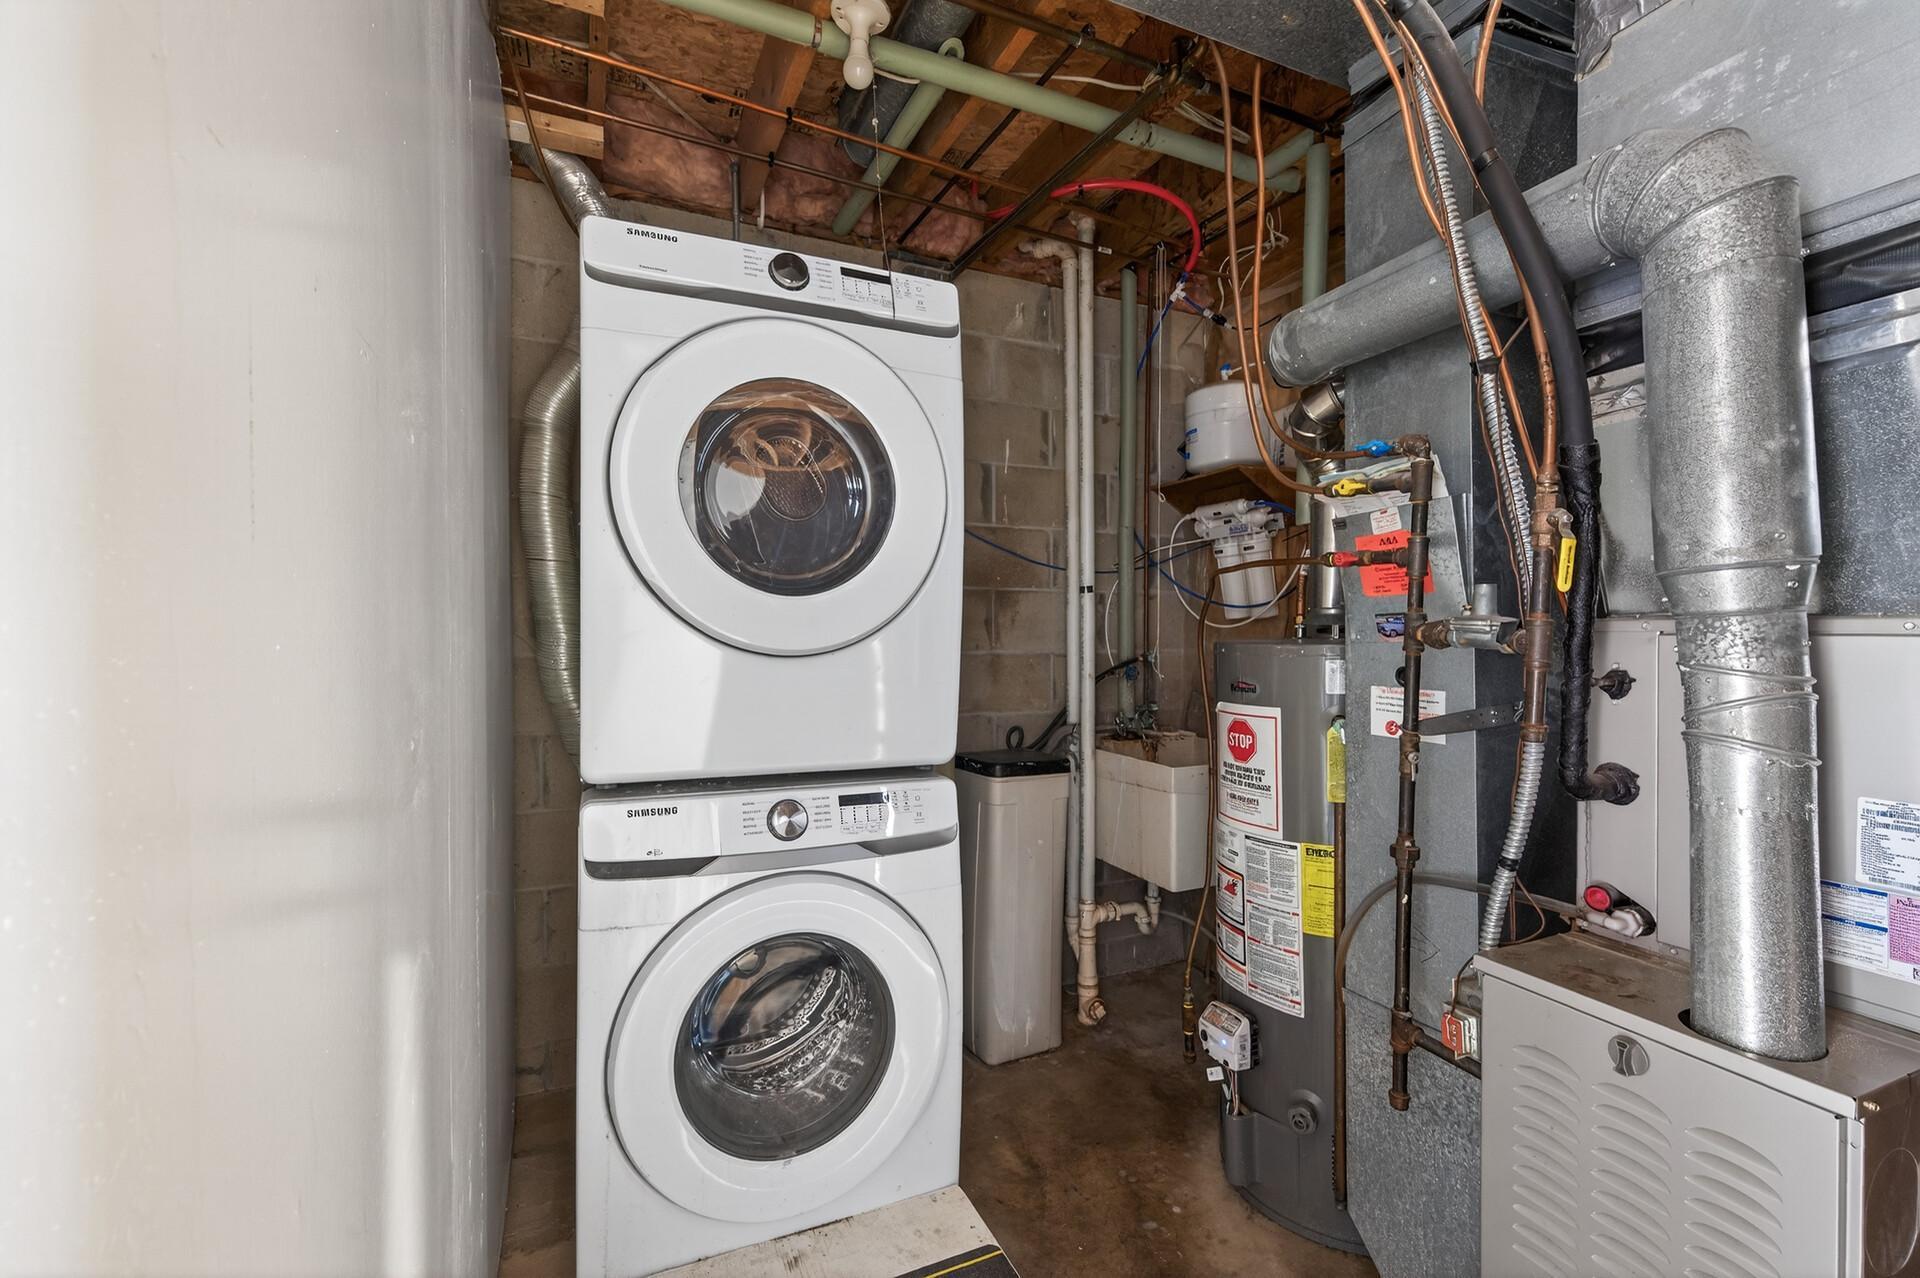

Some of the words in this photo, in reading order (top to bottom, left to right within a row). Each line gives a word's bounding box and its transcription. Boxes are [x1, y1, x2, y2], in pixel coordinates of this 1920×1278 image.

[626, 227, 678, 243] SAMSUNG
[1228, 731, 1253, 750] STOP
[626, 806, 678, 818] SAMSUNG
